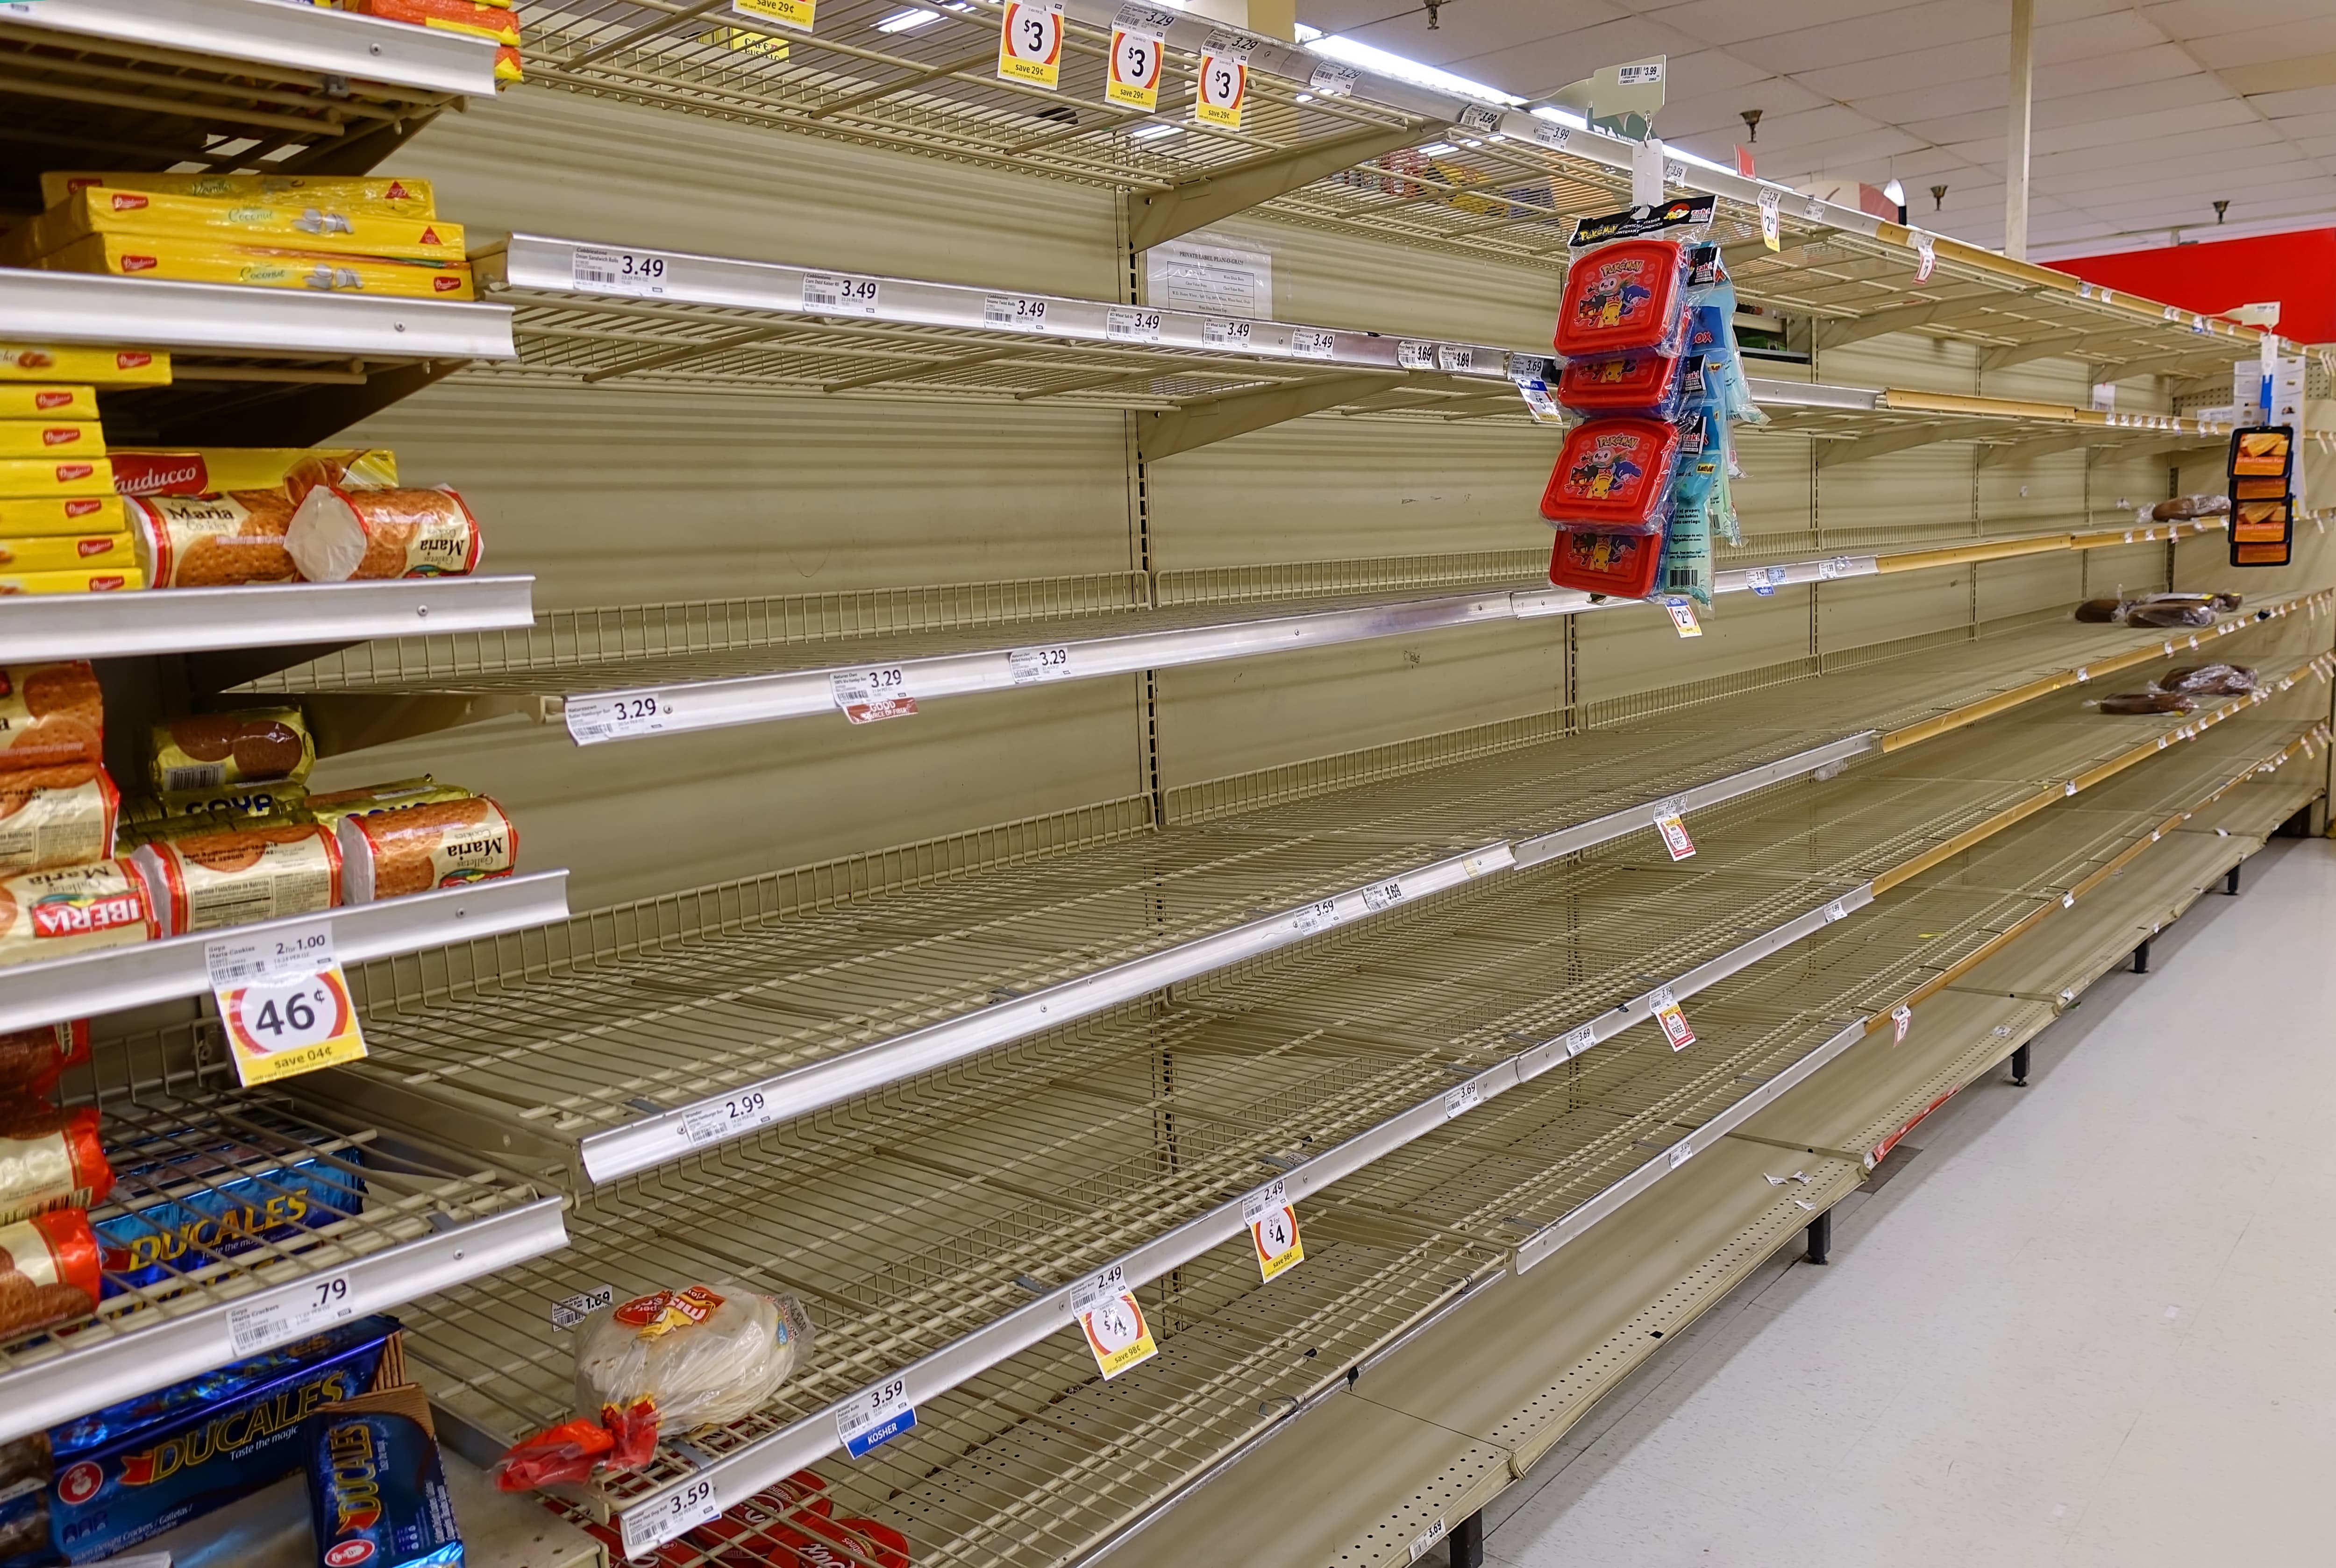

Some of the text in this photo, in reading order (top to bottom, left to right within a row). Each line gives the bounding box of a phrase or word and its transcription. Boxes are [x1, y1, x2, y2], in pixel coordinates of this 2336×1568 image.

[778, 1, 794, 14] 29¢
[1146, 10, 1175, 26] 3.29
[1232, 37, 1258, 50] 3.29
[1015, 64, 1044, 76] save 29¢
[1338, 67, 1361, 79] 3.29
[1120, 88, 1144, 99] save 29¢
[1221, 110, 1230, 119] 29¢
[1479, 112, 1497, 124] 3.99
[1553, 127, 1570, 140] 3.99
[228, 208, 274, 223] Coconut
[622, 255, 664, 277] 3.49
[1179, 251, 1199, 260] PRIVATE
[1214, 256, 1244, 266] PLAN-O-GRAM
[240, 266, 286, 281] Coconut
[841, 280, 876, 299] 3.49
[1017, 300, 1045, 317] 3.49
[1134, 313, 1160, 329] 3.49
[1227, 322, 1250, 337] 3.49
[1313, 333, 1333, 348] 3.49
[1417, 346, 1432, 362] 3.69
[1456, 352, 1470, 368] 3.89
[1526, 360, 1542, 371] 3.69
[114, 468, 198, 495] auducco
[166, 506, 235, 521] Maria
[420, 539, 465, 556] Maria
[1040, 649, 1066, 666] 3.29
[869, 669, 903, 688] 3.29
[614, 698, 656, 721] 3.29
[869, 700, 896, 713] GOOD
[893, 707, 907, 715] FIBER
[447, 837, 502, 856] Maria
[1385, 883, 1402, 900] 3.69
[36, 898, 140, 934] IBERIA
[276, 943, 285, 955] 2
[297, 934, 326, 951] 1.00
[1662, 986, 1672, 999] 3.19
[256, 988, 326, 1036] 46¢
[1579, 1028, 1590, 1042] 3.69
[1672, 1024, 1685, 1036] FREE
[274, 1054, 305, 1069] save
[307, 1046, 333, 1061] 04¢
[1461, 1082, 1476, 1098] 3.69
[726, 1093, 764, 1119] 2.99
[1264, 1182, 1283, 1201] 2.49
[128, 1188, 309, 1271] DUCALES
[1273, 1251, 1293, 1269] save 98¢
[1097, 1266, 1121, 1289] 2.49
[313, 1278, 347, 1308] .79
[1103, 1310, 1109, 1319] 2
[1114, 1344, 1141, 1364] save 98¢
[871, 1380, 903, 1408] 3.59
[150, 1371, 344, 1484] DUCALES
[867, 1422, 897, 1446] KOSHER
[229, 1424, 299, 1462] Taste the magic
[670, 1482, 709, 1515] 3.59
[123, 1520, 153, 1541] Crackers
